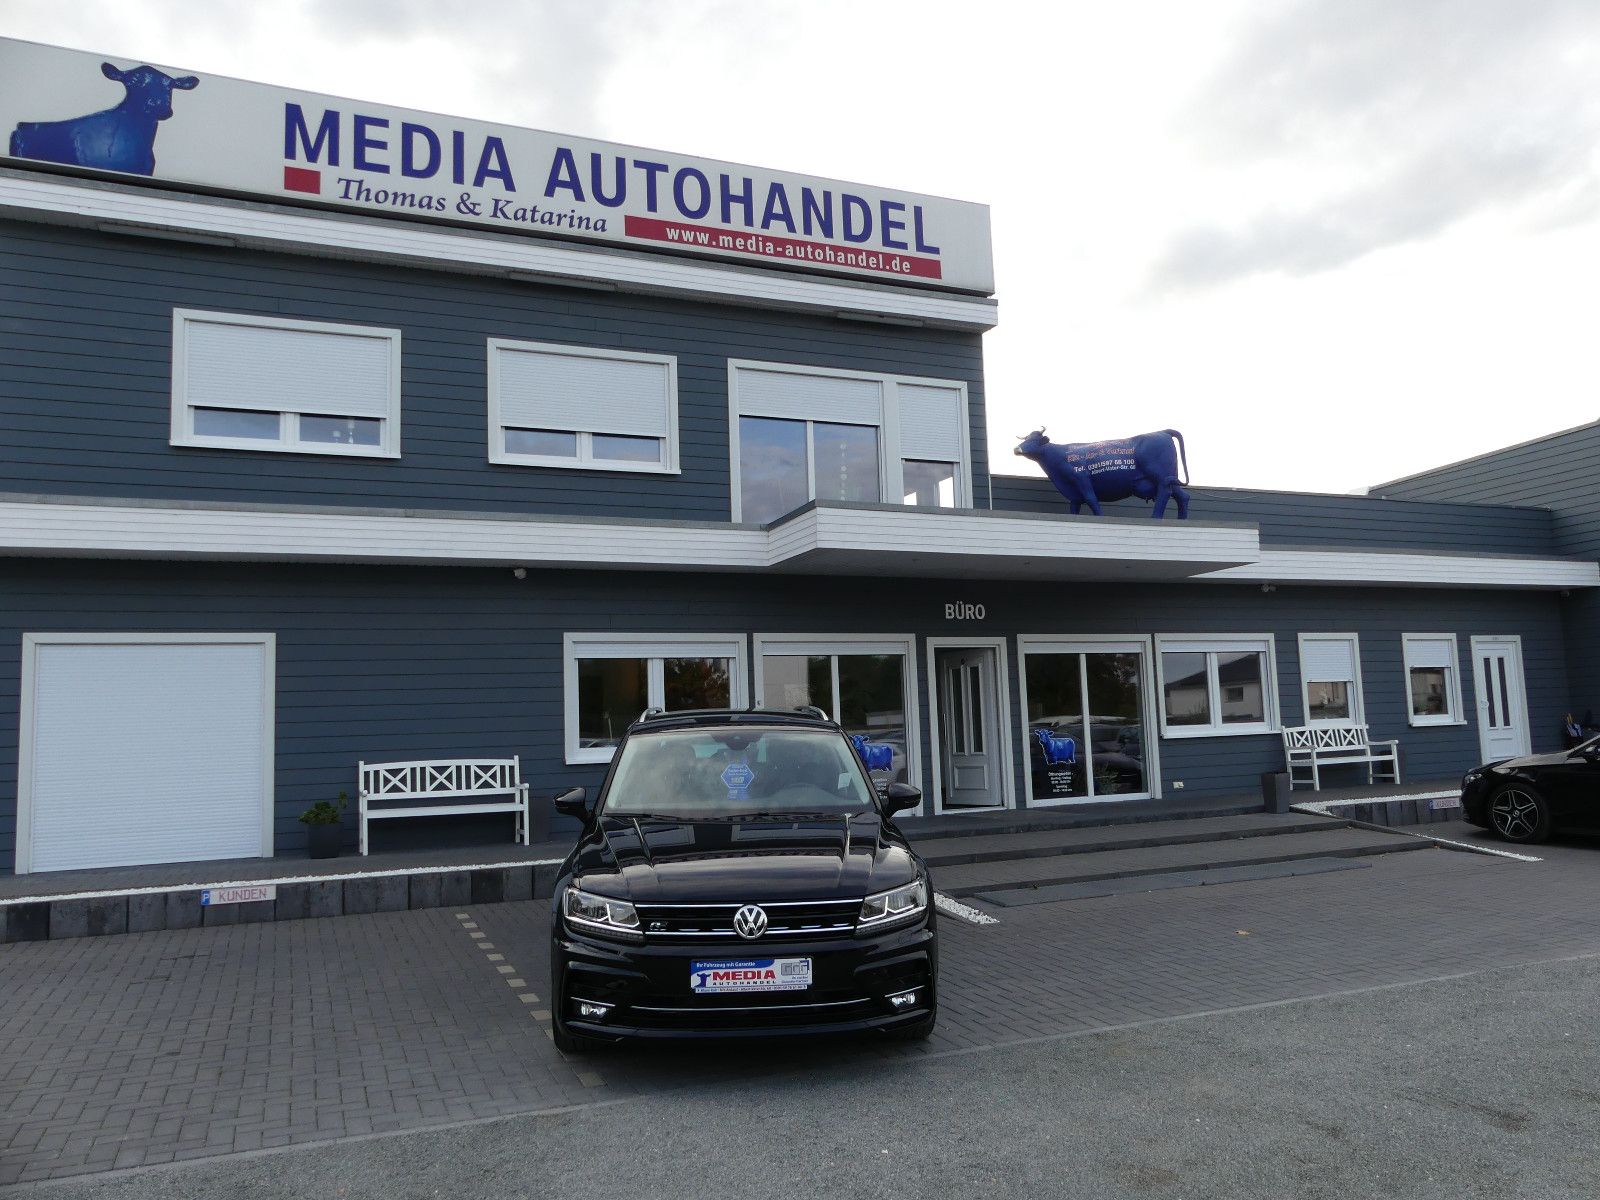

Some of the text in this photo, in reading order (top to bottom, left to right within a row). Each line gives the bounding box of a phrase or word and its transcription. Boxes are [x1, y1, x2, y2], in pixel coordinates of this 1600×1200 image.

[284, 102, 941, 256] MEDIA AUTOHANDEL
[337, 177, 608, 233] Thomas & Katarina
[665, 224, 912, 274] www.media-autohandel.de
[1074, 465, 1086, 473] Tel.
[1124, 458, 1135, 466] 100
[945, 600, 986, 620] BÜRO
[218, 888, 267, 902] KUNDEN
[712, 970, 776, 981] MEDIA
